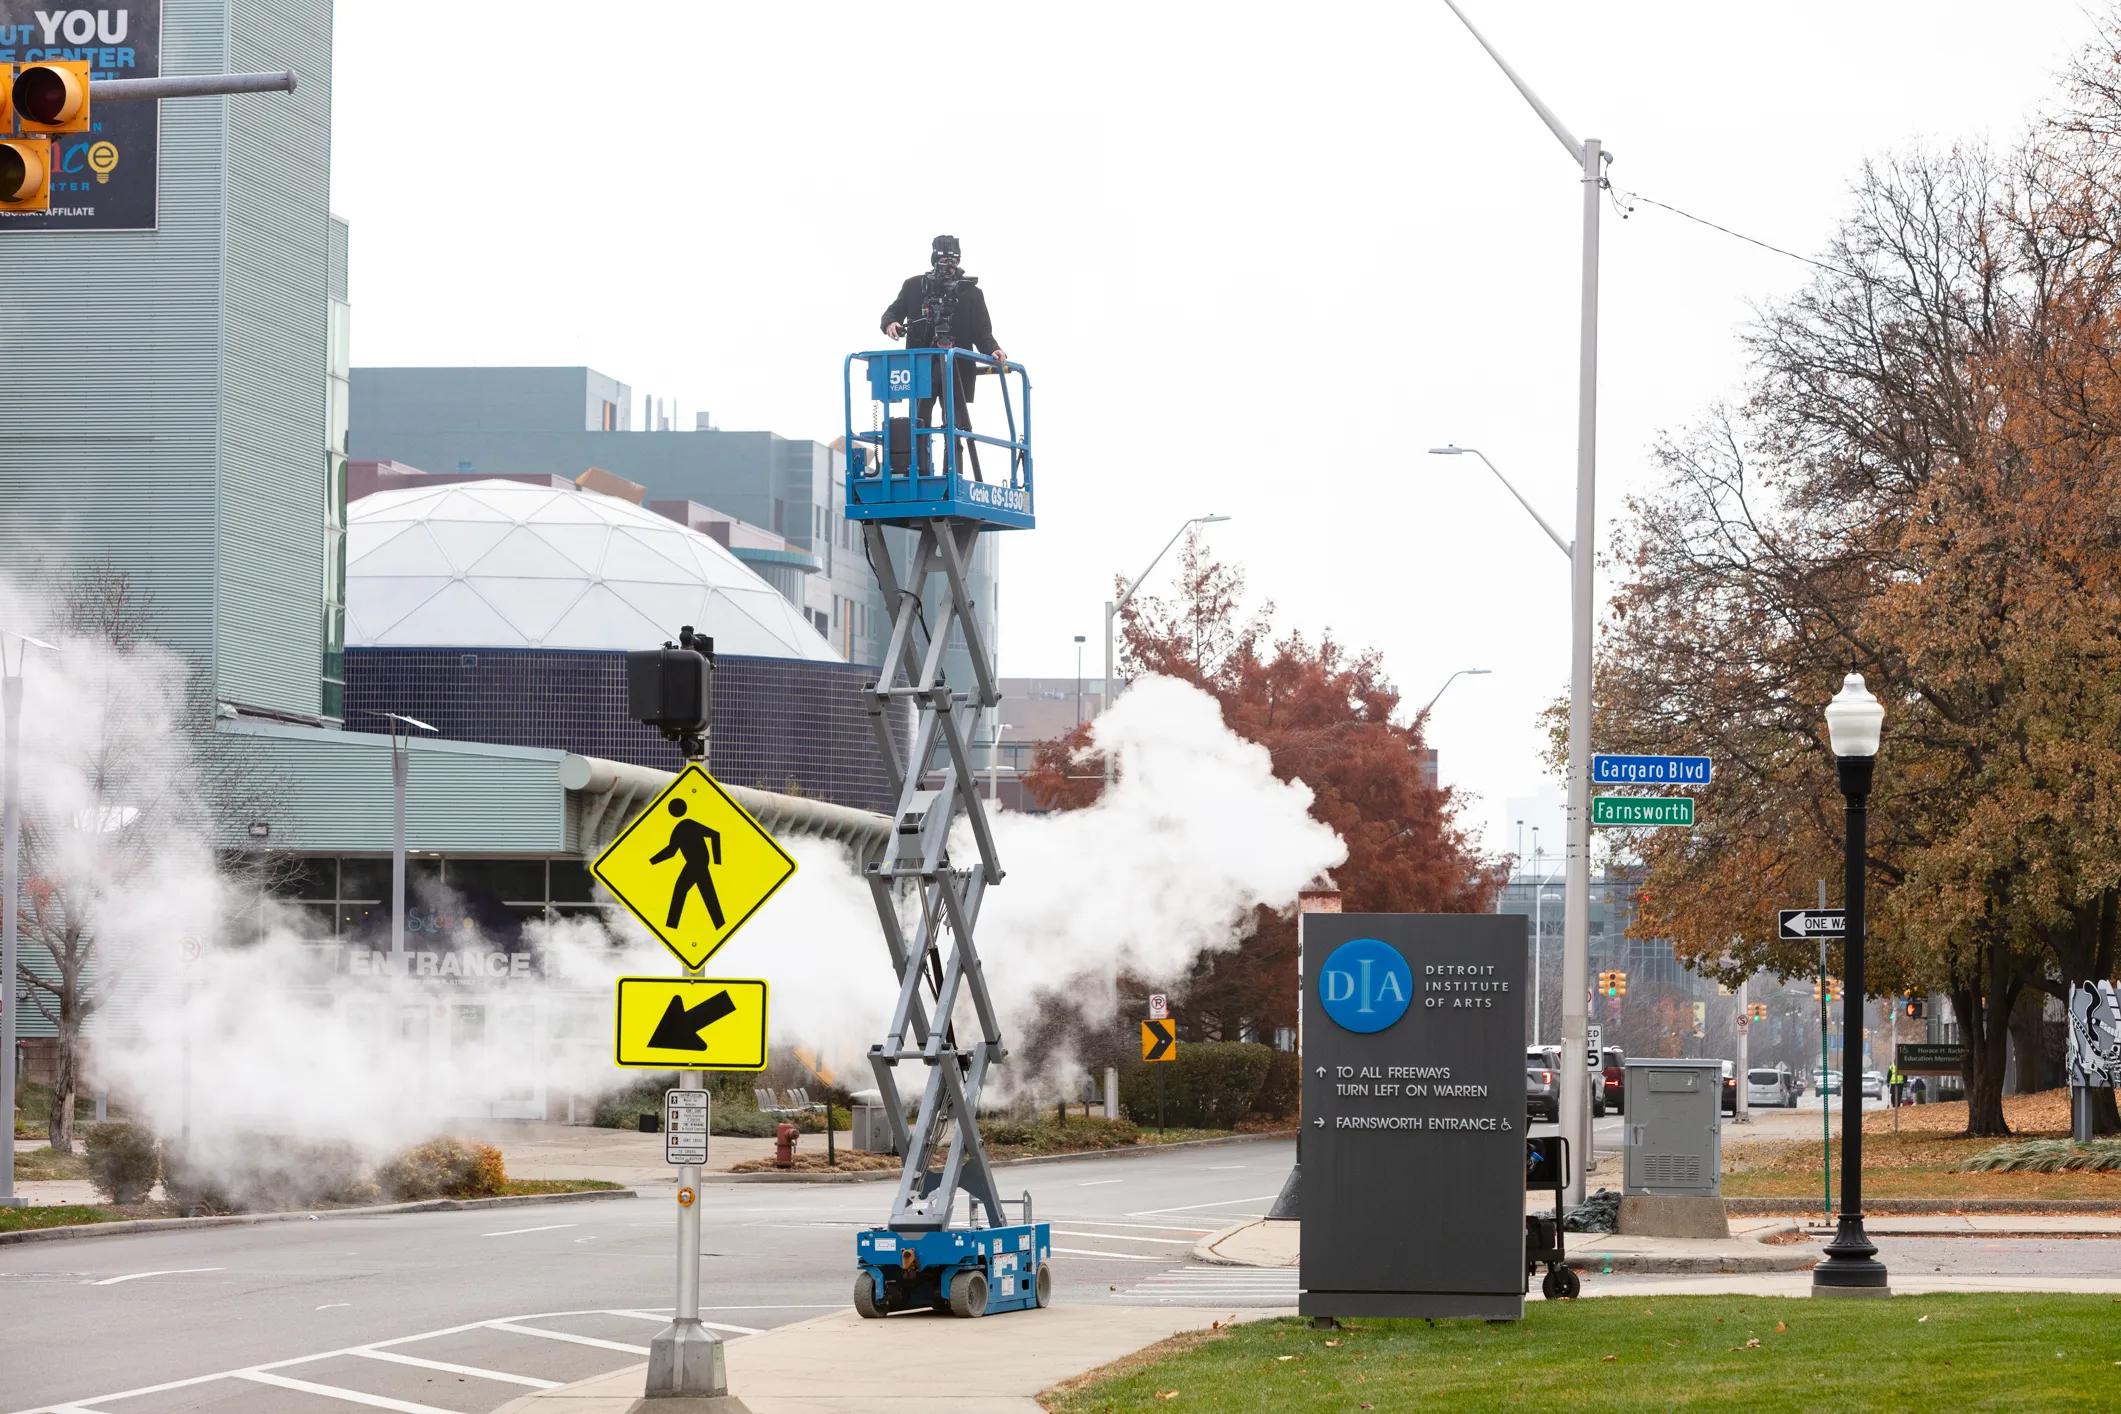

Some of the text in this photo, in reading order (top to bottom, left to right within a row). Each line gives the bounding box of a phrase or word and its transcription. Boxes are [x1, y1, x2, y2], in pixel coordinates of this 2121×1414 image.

[34, 9, 128, 45] YOU
[45, 207, 95, 216] AFFILIATE
[889, 369, 911, 385] 50
[969, 483, 990, 503] Genie
[991, 486, 1024, 510] GS-1930
[1601, 760, 1703, 781] Gargaro Blvd
[1598, 802, 1689, 820] Farnsworth
[1804, 918, 1846, 929] ONE WA
[350, 951, 531, 978] ENTRANCE
[1425, 965, 1495, 975] DETROIT
[1326, 959, 1405, 1013] DIA
[1425, 981, 1509, 992] INSTITUTE
[1425, 998, 1492, 1008] OF ARTS
[1588, 1050, 1599, 1067] 5
[1336, 1066, 1450, 1079] TO ALL FREEWAYS
[1336, 1084, 1488, 1097] TURN LEFT ON WARREN
[1336, 1117, 1496, 1131] FARNSWORTH ENTRANCE
